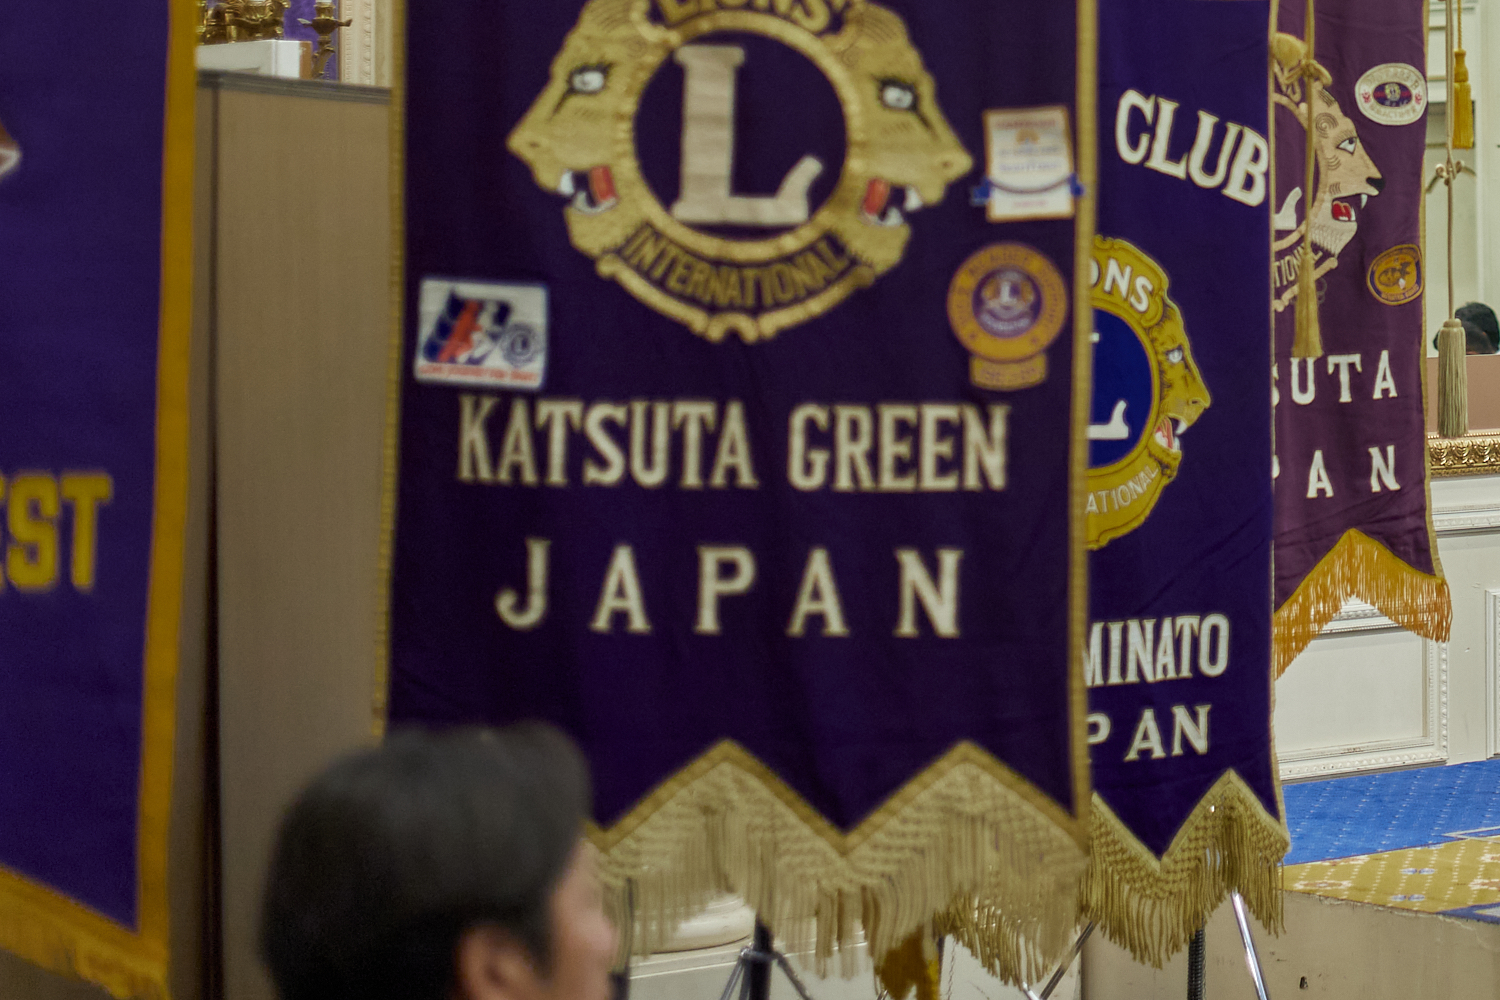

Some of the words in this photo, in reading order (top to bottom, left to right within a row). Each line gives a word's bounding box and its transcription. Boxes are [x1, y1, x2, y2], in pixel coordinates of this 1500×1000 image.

[671, 44, 823, 227] L
[1114, 89, 1270, 208] CLUB
[621, 224, 851, 308] INTERNATIONAL
[1272, 349, 1399, 406] UTA
[457, 394, 760, 489] KATSUTA
[787, 403, 1010, 493] GREEN
[0, 472, 114, 594] ST
[494, 538, 964, 639] JAPAN
